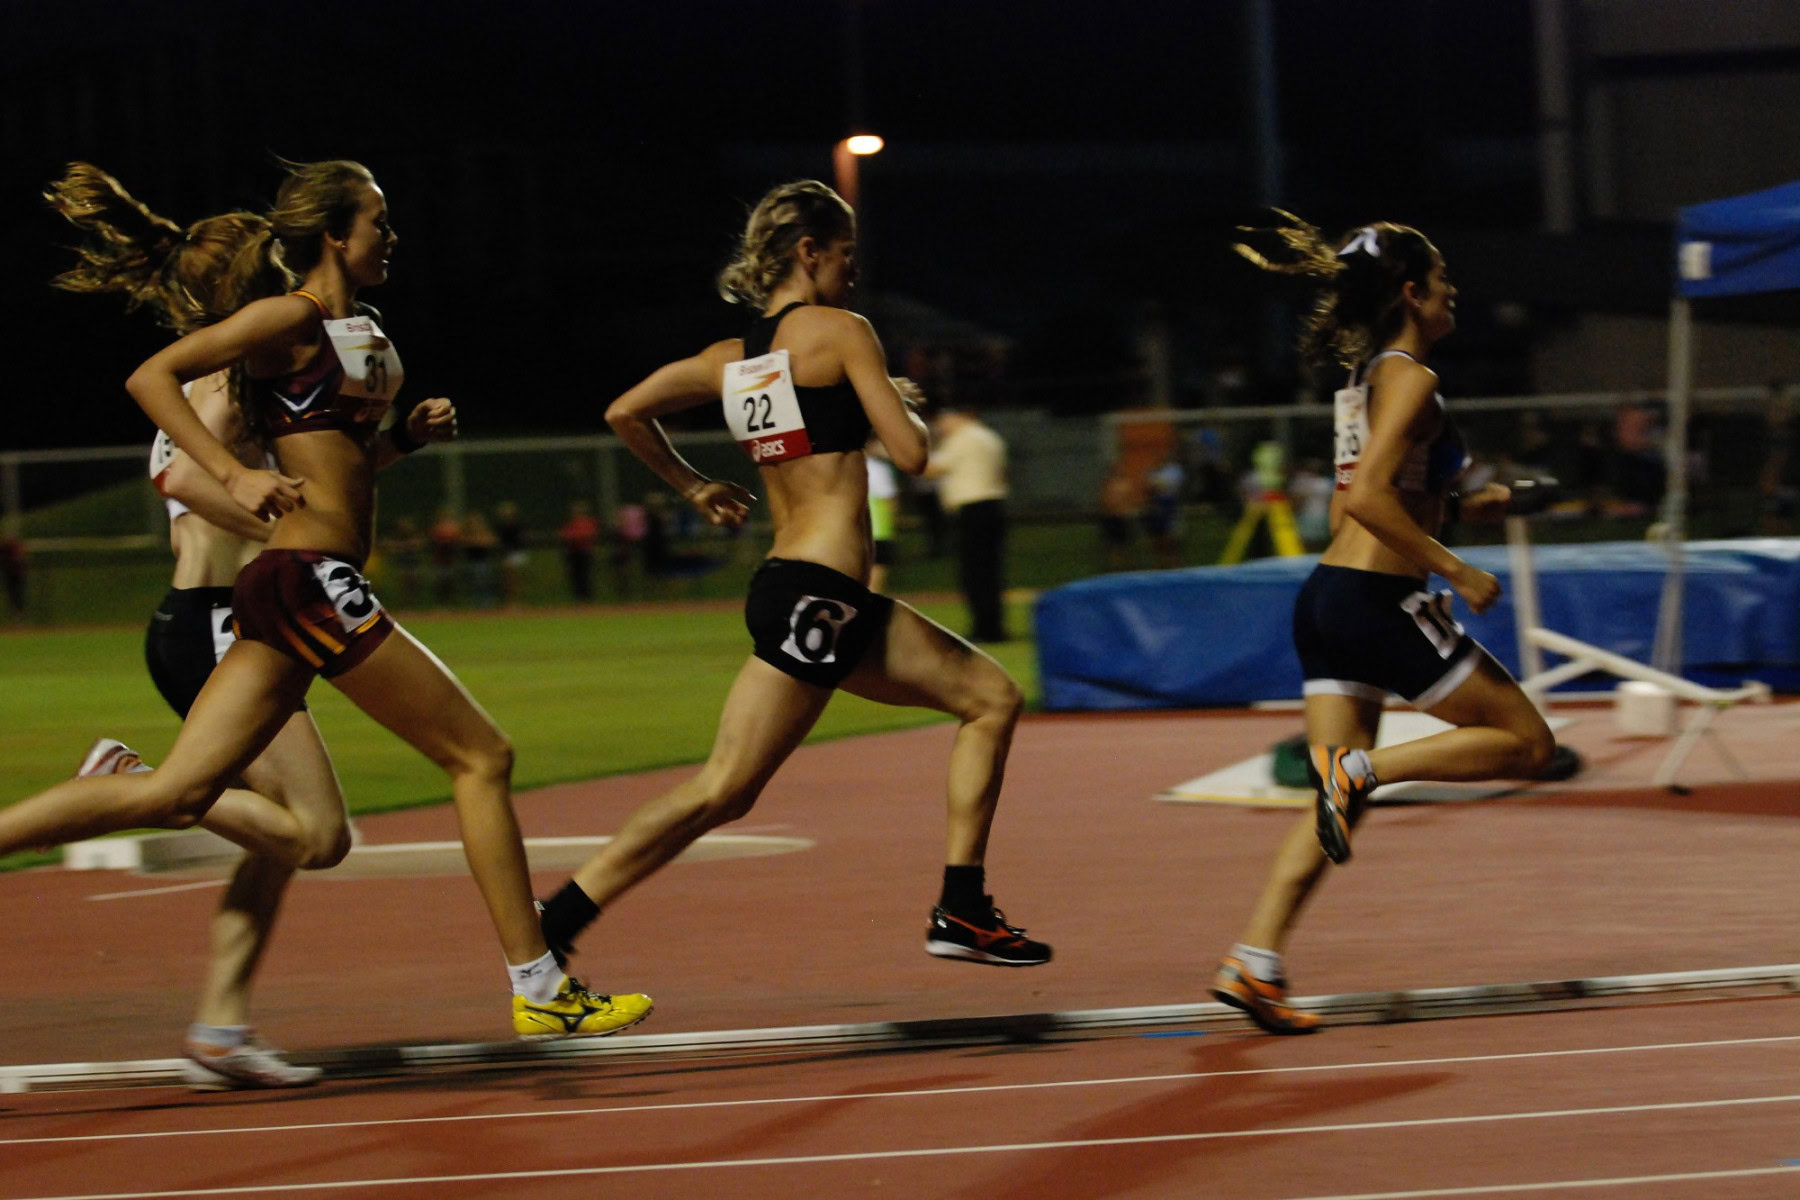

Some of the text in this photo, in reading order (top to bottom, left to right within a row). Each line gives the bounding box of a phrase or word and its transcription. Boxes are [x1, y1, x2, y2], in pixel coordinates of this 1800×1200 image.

[743, 393, 776, 433] 22
[328, 567, 375, 618] 3
[795, 600, 844, 662] 6
